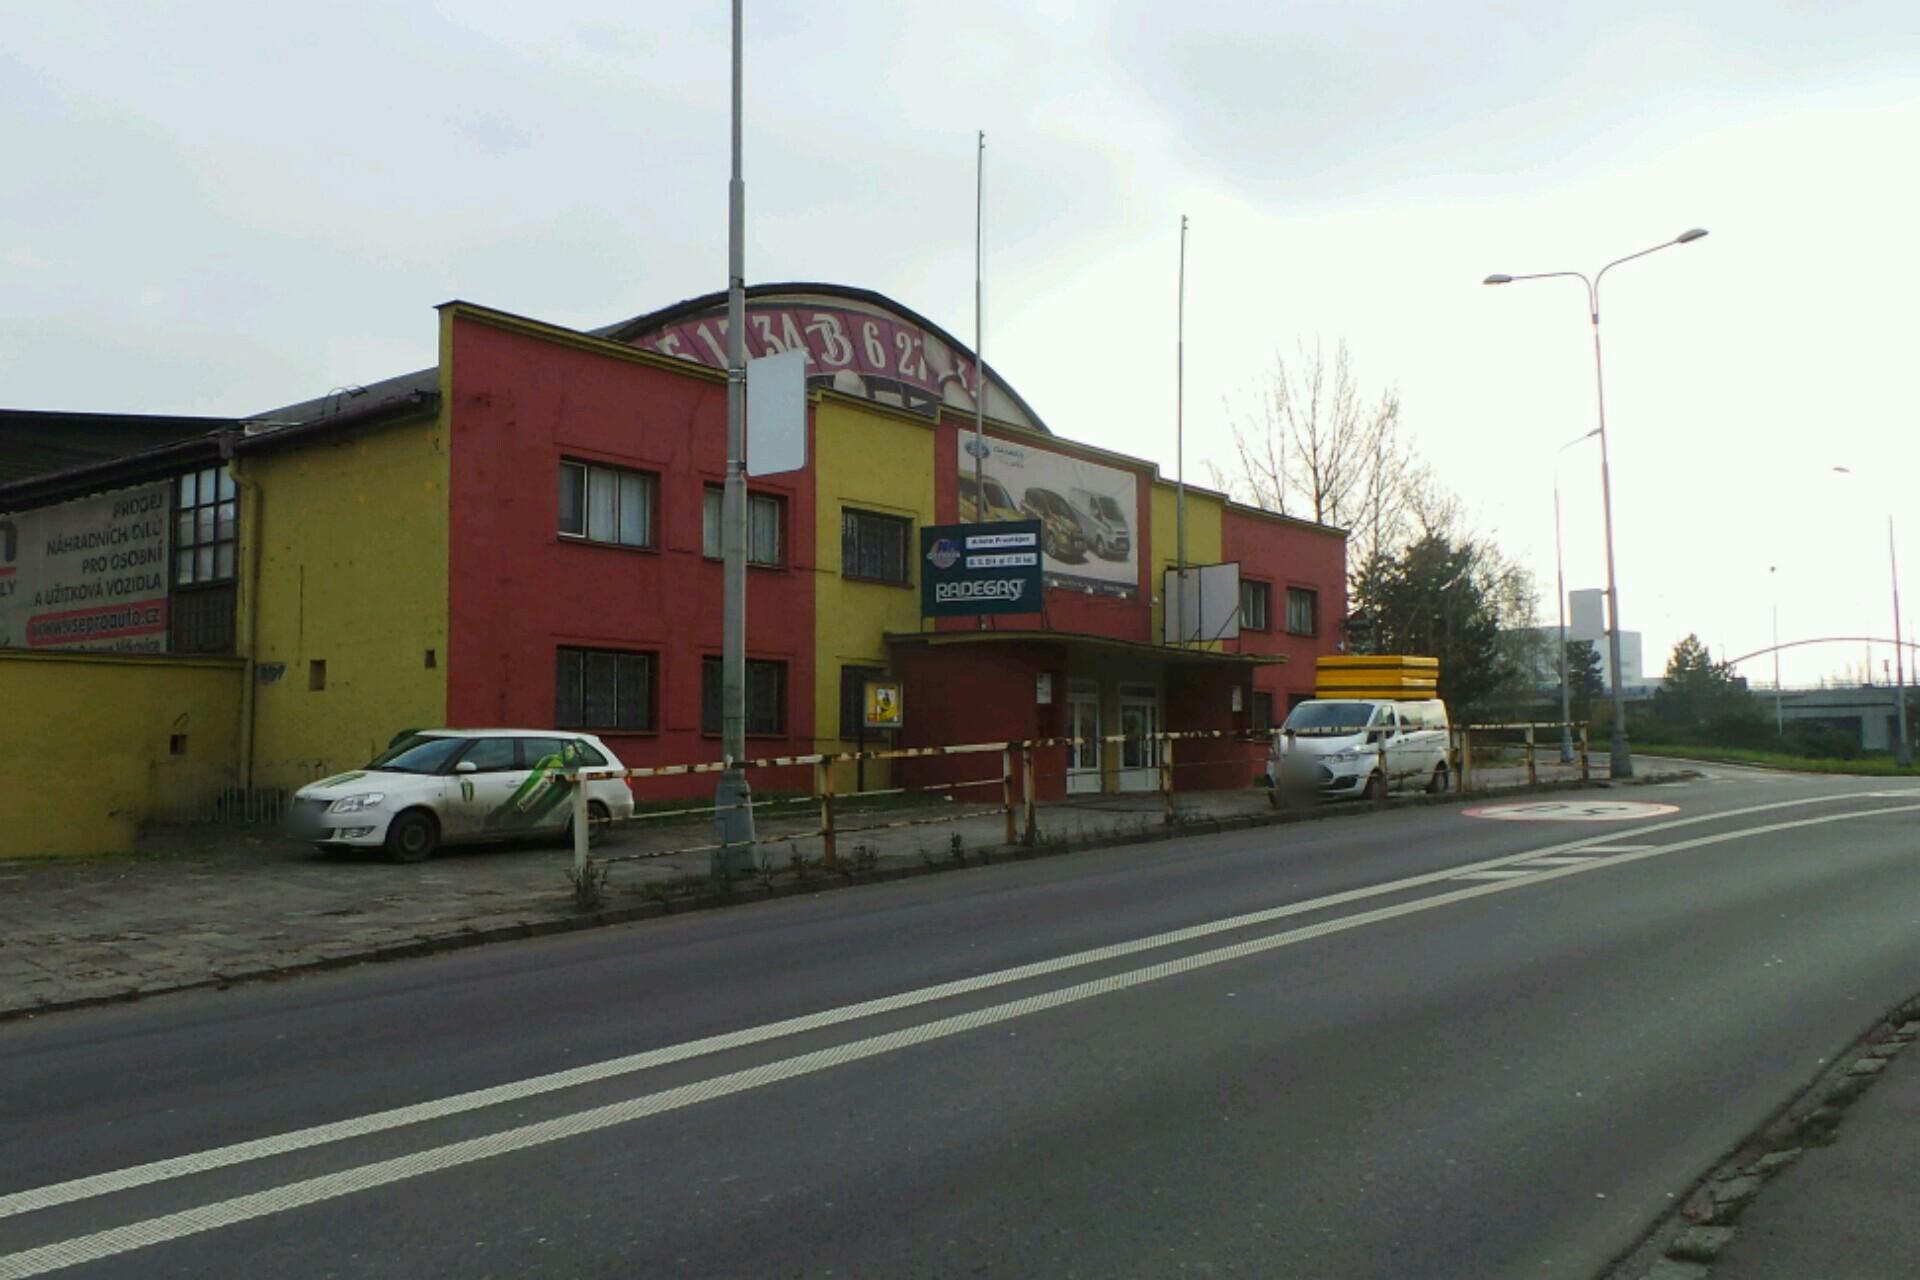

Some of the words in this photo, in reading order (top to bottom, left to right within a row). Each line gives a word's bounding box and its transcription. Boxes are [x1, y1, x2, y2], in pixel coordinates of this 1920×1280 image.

[863, 320, 886, 370] 6
[112, 494, 163, 519] PRODEJ
[46, 525, 129, 557] NÁHRADNÍCH
[82, 556, 108, 575] PRO
[110, 540, 163, 571] OSOBNÍ
[34, 590, 43, 608] A
[45, 577, 105, 606] UŽITKOVÁ
[107, 572, 162, 597] VOZIDLA
[935, 577, 1027, 604] RADEGAST
